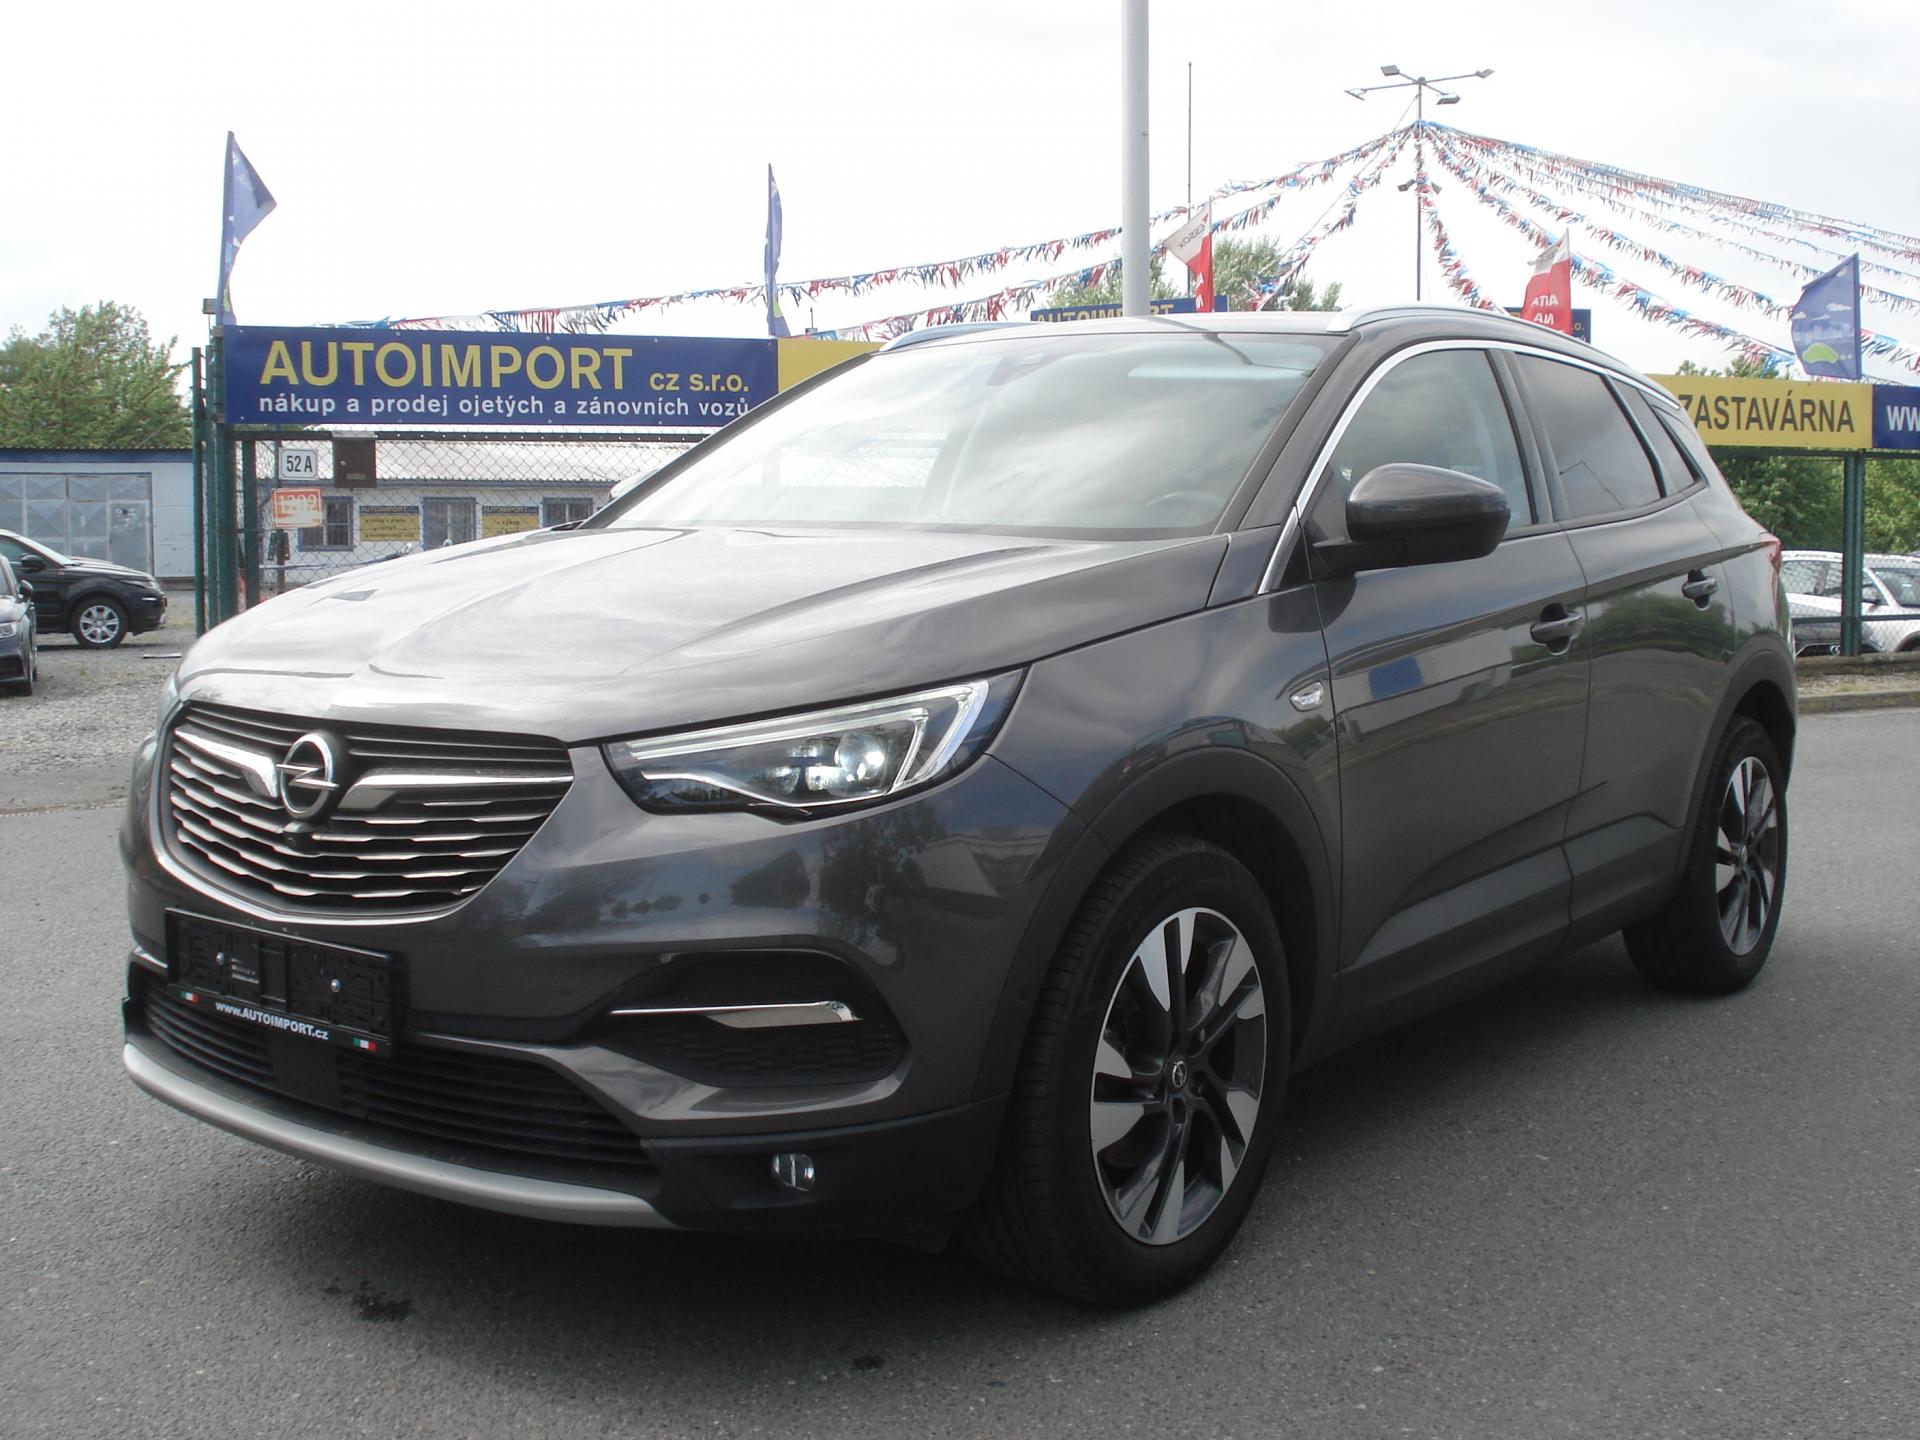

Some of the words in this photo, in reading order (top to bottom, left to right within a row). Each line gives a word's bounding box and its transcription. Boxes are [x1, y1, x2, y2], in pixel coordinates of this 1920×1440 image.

[259, 340, 633, 390] AUTOIMPORT
[649, 372, 680, 391] cz
[688, 373, 749, 392] s.r.o.
[259, 393, 336, 416] nákup
[346, 399, 360, 413] a
[371, 394, 448, 416] prodej
[459, 394, 543, 417] ojetých
[554, 400, 566, 414] a
[576, 396, 689, 416] zánovních
[699, 397, 749, 416] vozů
[286, 455, 302, 472] 52
[304, 455, 313, 472] A
[215, 1002, 329, 1040] www.AUTOIMPORT.cz
